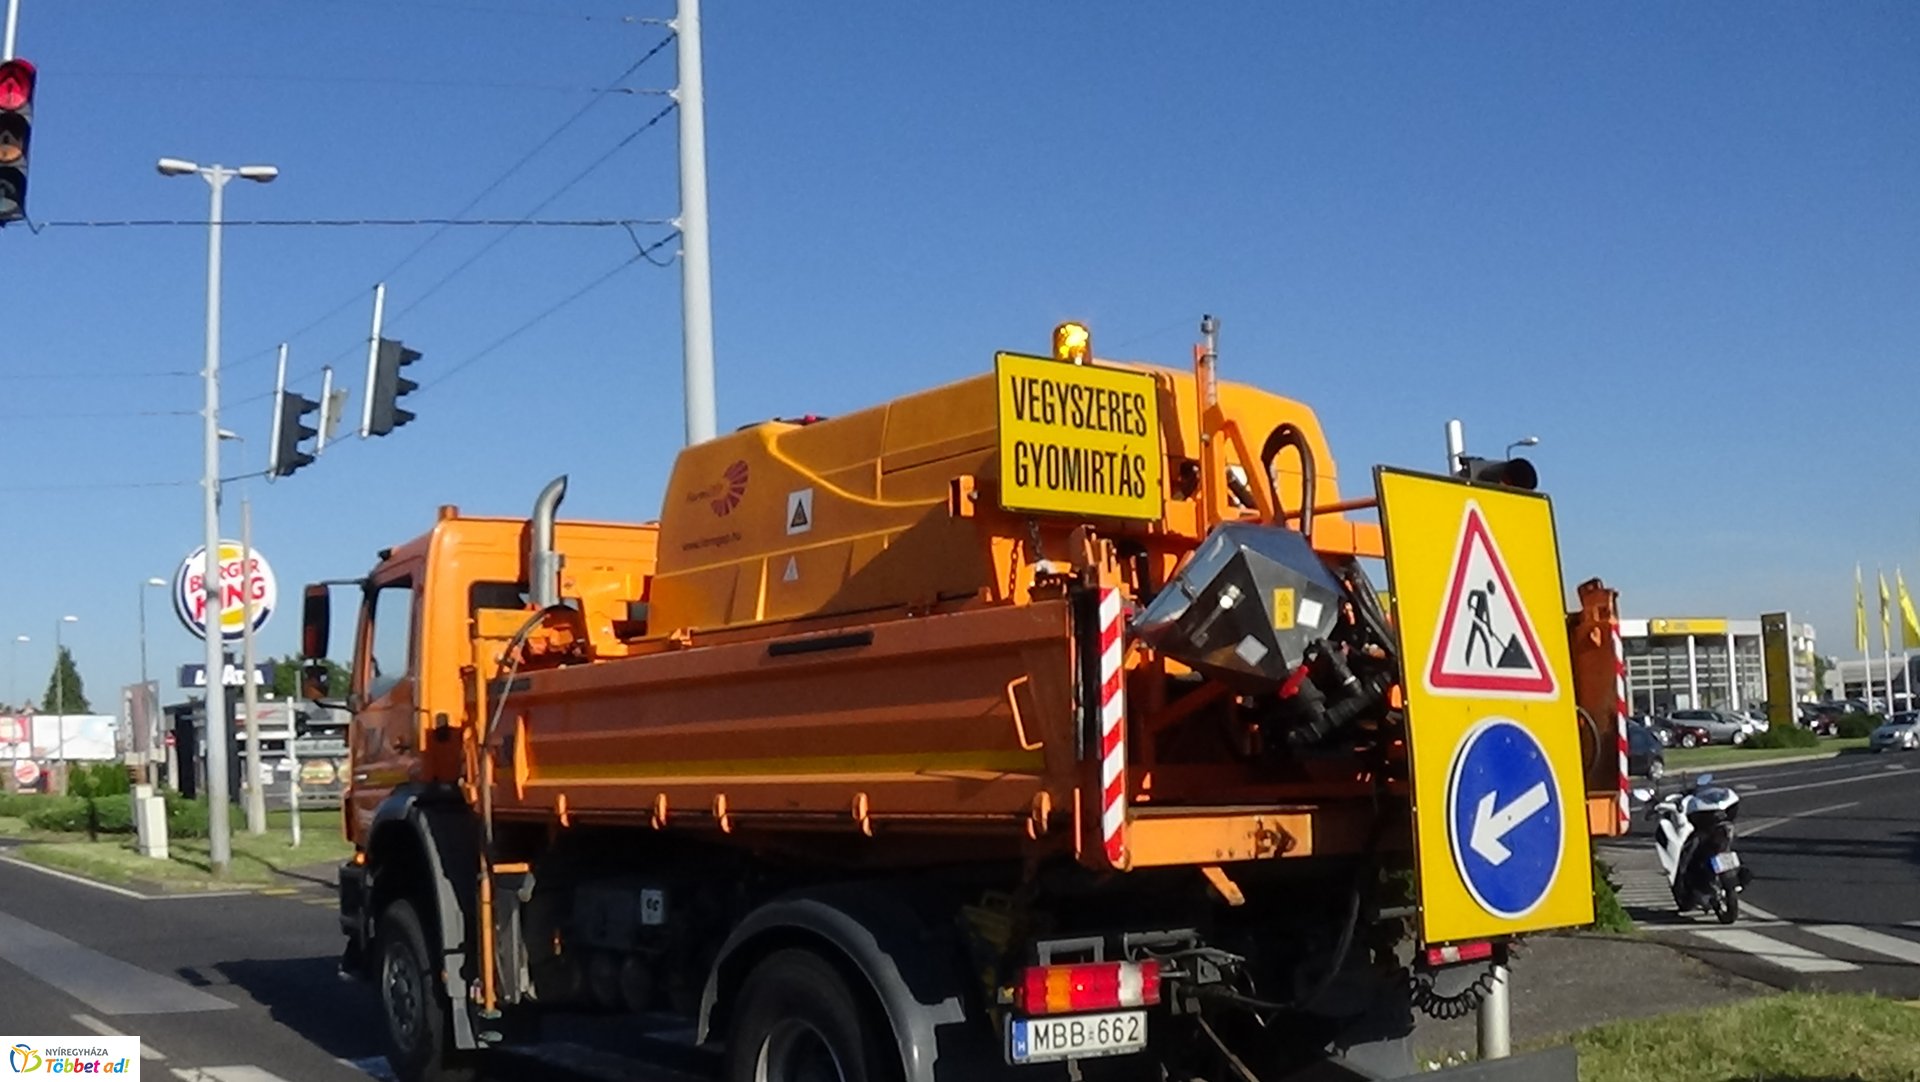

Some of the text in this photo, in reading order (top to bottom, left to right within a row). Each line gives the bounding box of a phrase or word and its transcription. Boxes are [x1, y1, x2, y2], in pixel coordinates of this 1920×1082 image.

[1010, 375, 1147, 437] VEGYSZERES
[1014, 441, 1146, 499] GYOMIRTÁS
[189, 558, 260, 594] BRGR
